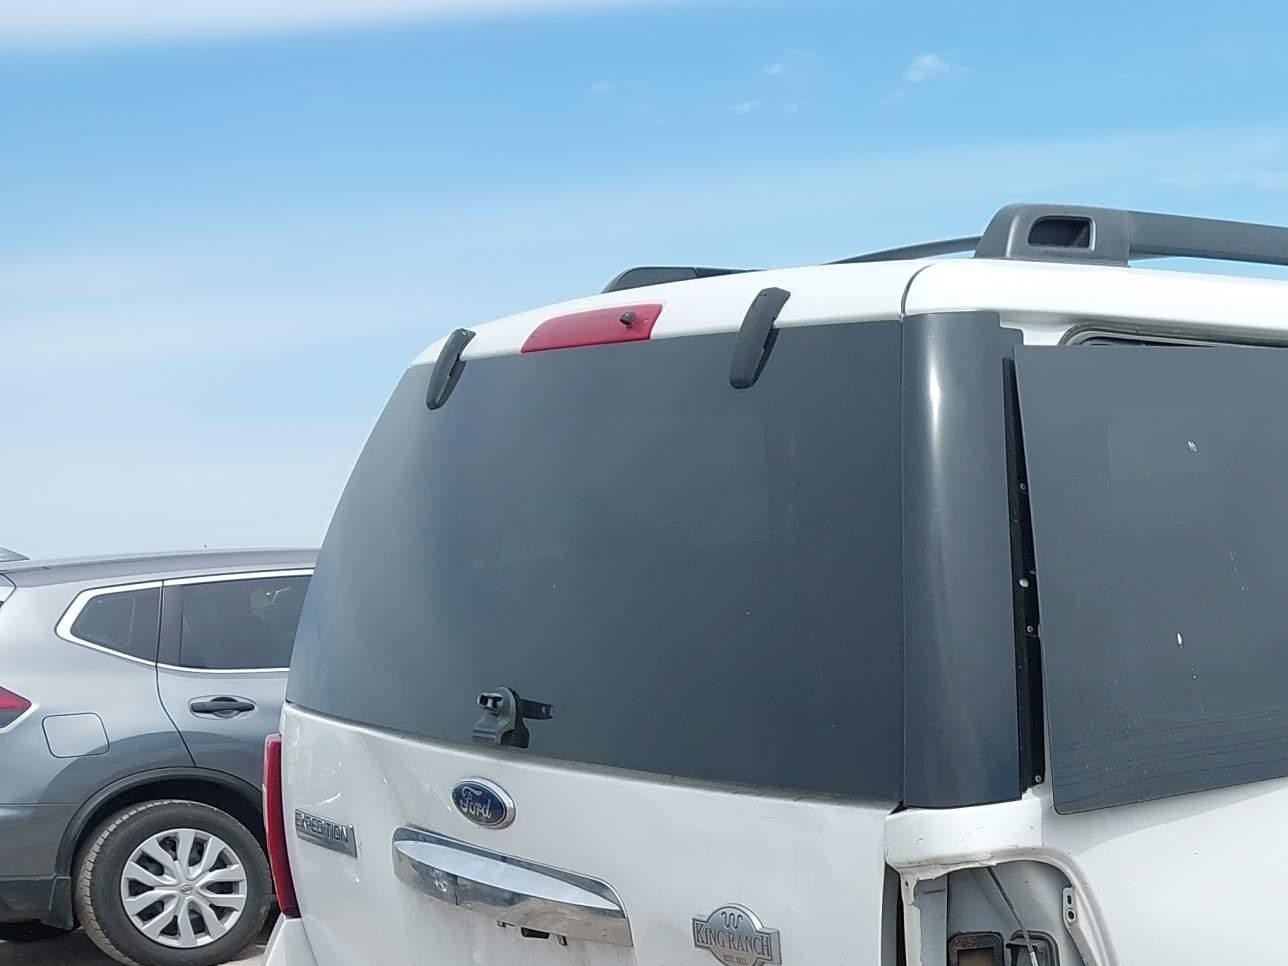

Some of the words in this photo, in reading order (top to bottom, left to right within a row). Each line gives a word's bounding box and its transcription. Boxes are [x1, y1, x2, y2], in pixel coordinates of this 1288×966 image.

[460, 786, 492, 818] Ford
[296, 811, 348, 842] EXPEDITION
[695, 923, 726, 948] KING
[728, 932, 770, 957] RANCH
